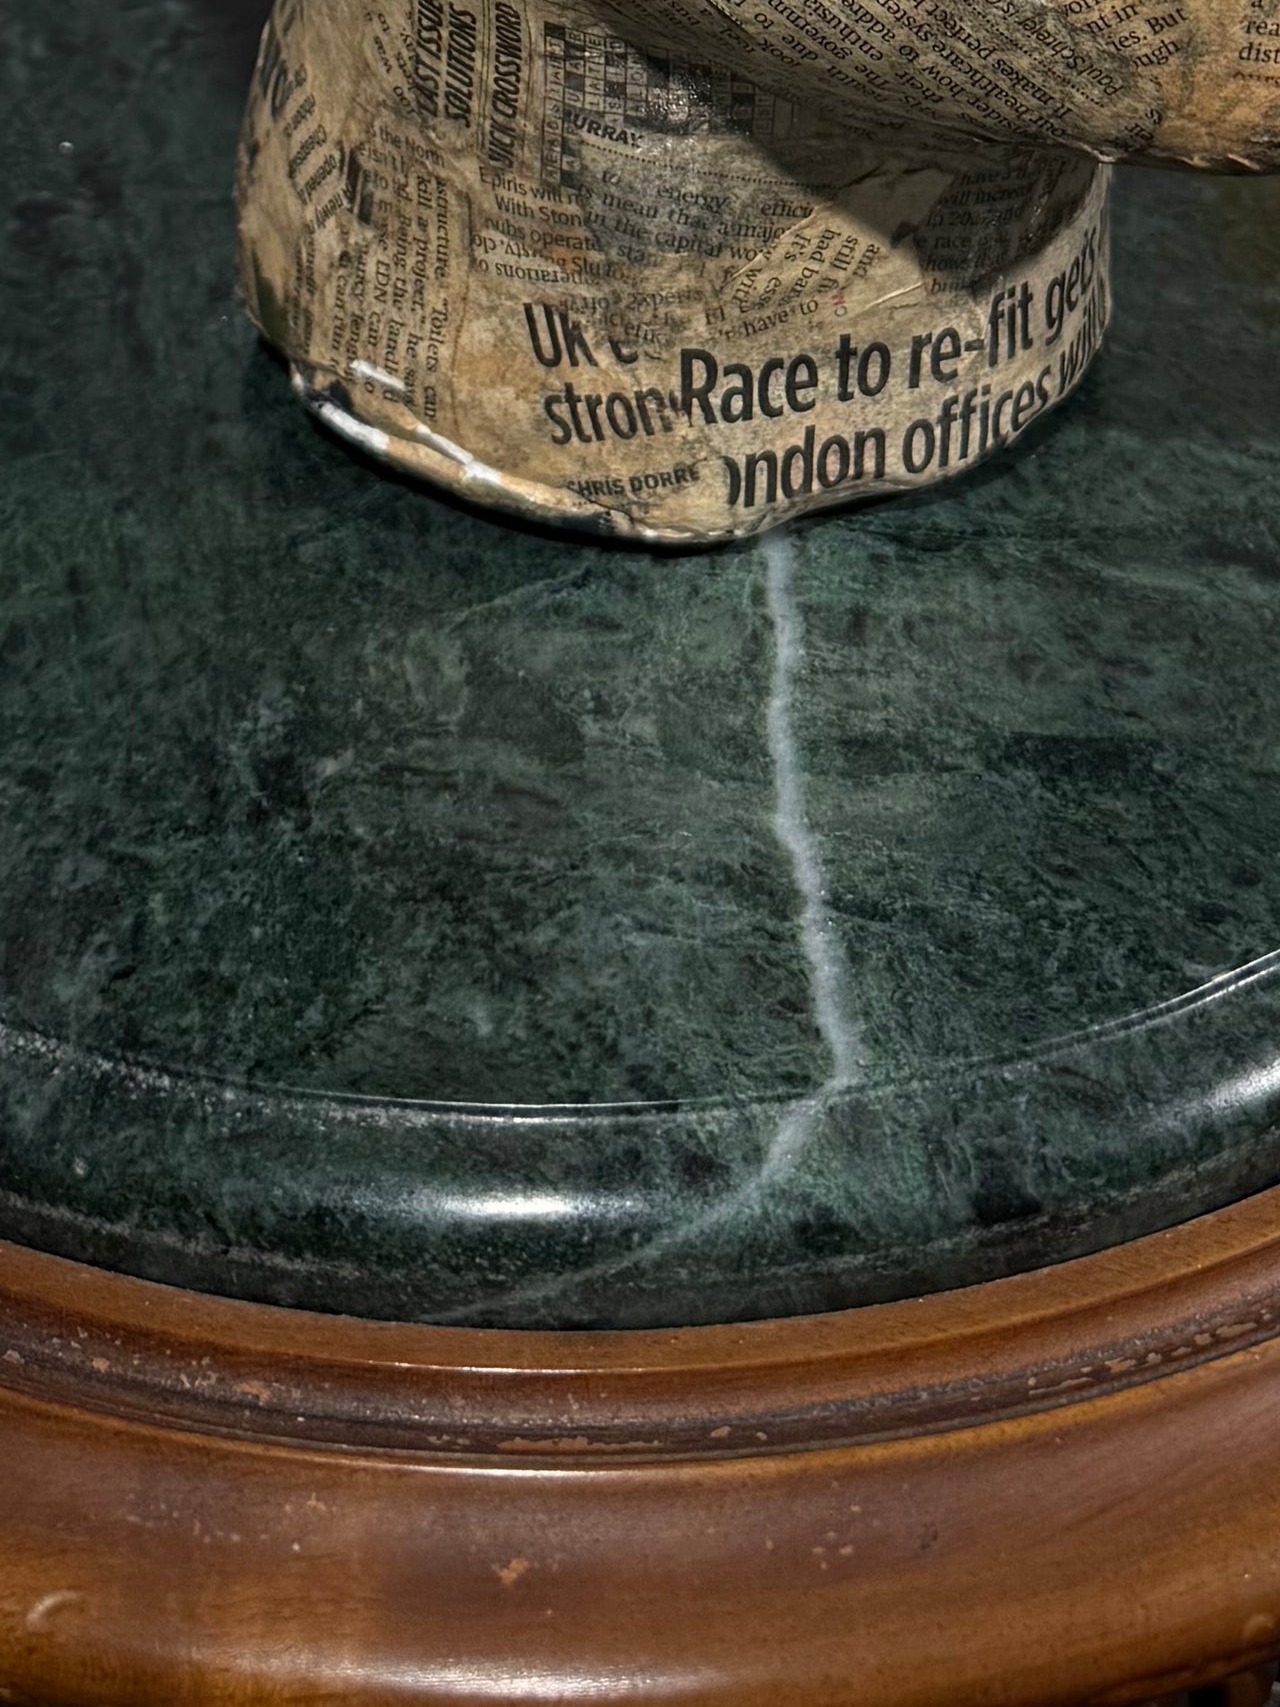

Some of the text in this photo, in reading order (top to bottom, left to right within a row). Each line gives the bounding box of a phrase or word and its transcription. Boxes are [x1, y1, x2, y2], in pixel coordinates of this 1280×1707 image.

[925, 4, 998, 61] perfect
[1111, 2, 1140, 25] in
[1146, 6, 1189, 37] But
[444, 3, 478, 129] SOLUTIONS
[493, 0, 523, 108] CROSSWORD
[932, 37, 1032, 119] healthcare
[992, 58, 1056, 107] makes
[494, 194, 535, 221] With
[742, 298, 820, 338] have to
[680, 347, 820, 427] Race
[834, 333, 893, 403] to
[907, 279, 1035, 390] re-fit
[901, 364, 1053, 475] offices
